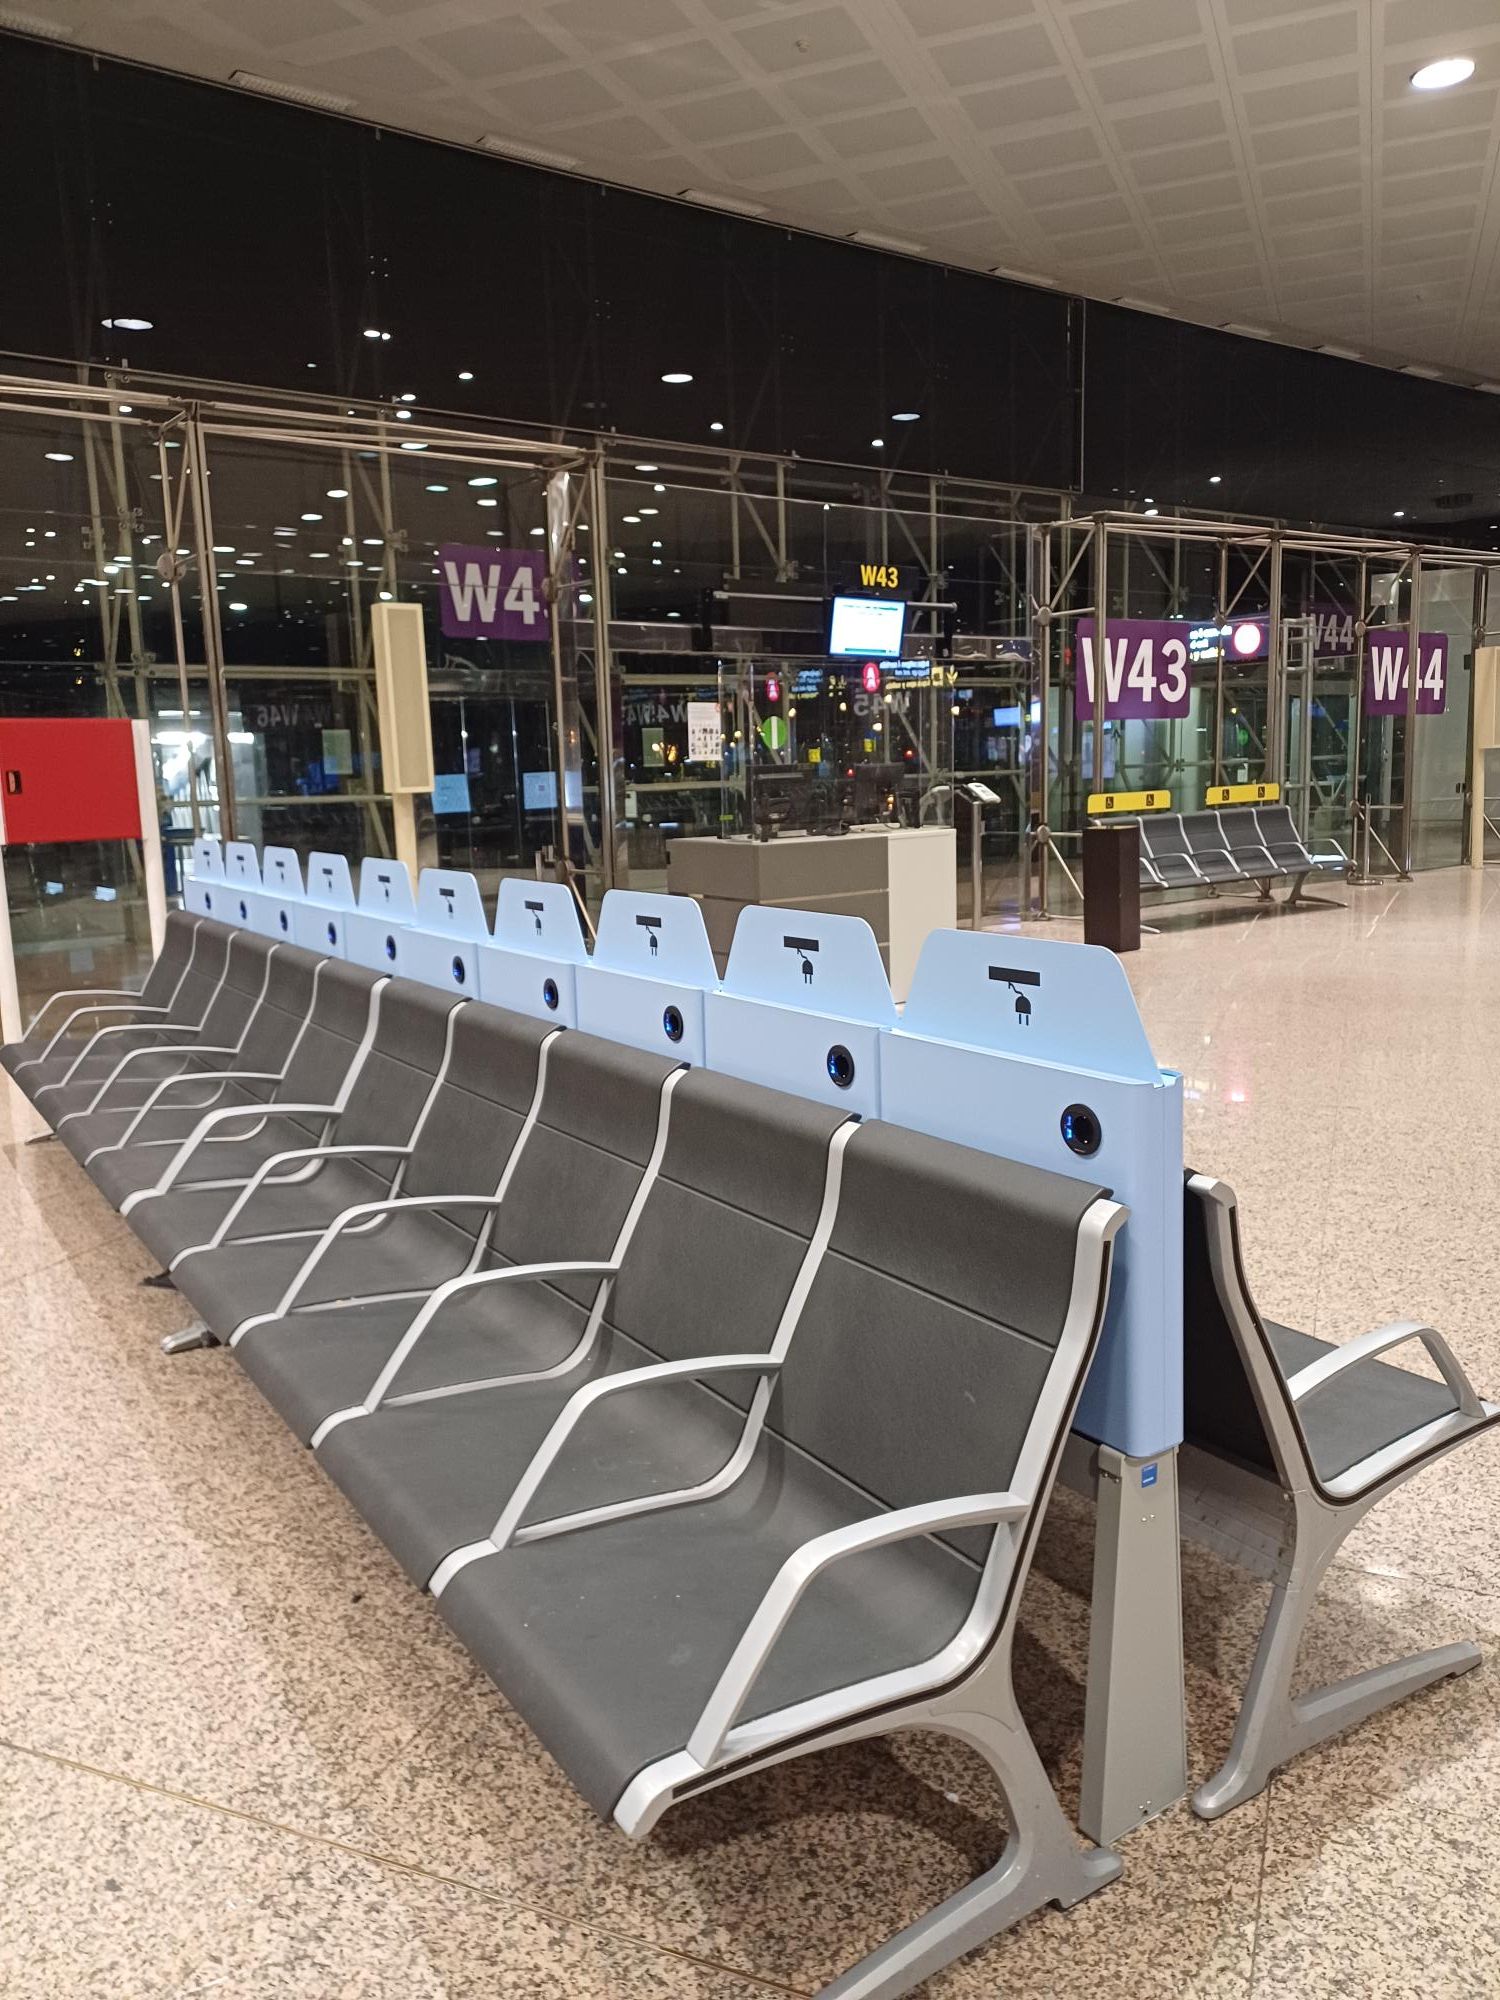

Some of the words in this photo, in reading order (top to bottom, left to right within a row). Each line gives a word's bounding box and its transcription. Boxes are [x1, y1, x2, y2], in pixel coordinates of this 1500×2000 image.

[443, 561, 549, 625] W4
[861, 564, 899, 588] W43
[1082, 637, 1187, 703] W43
